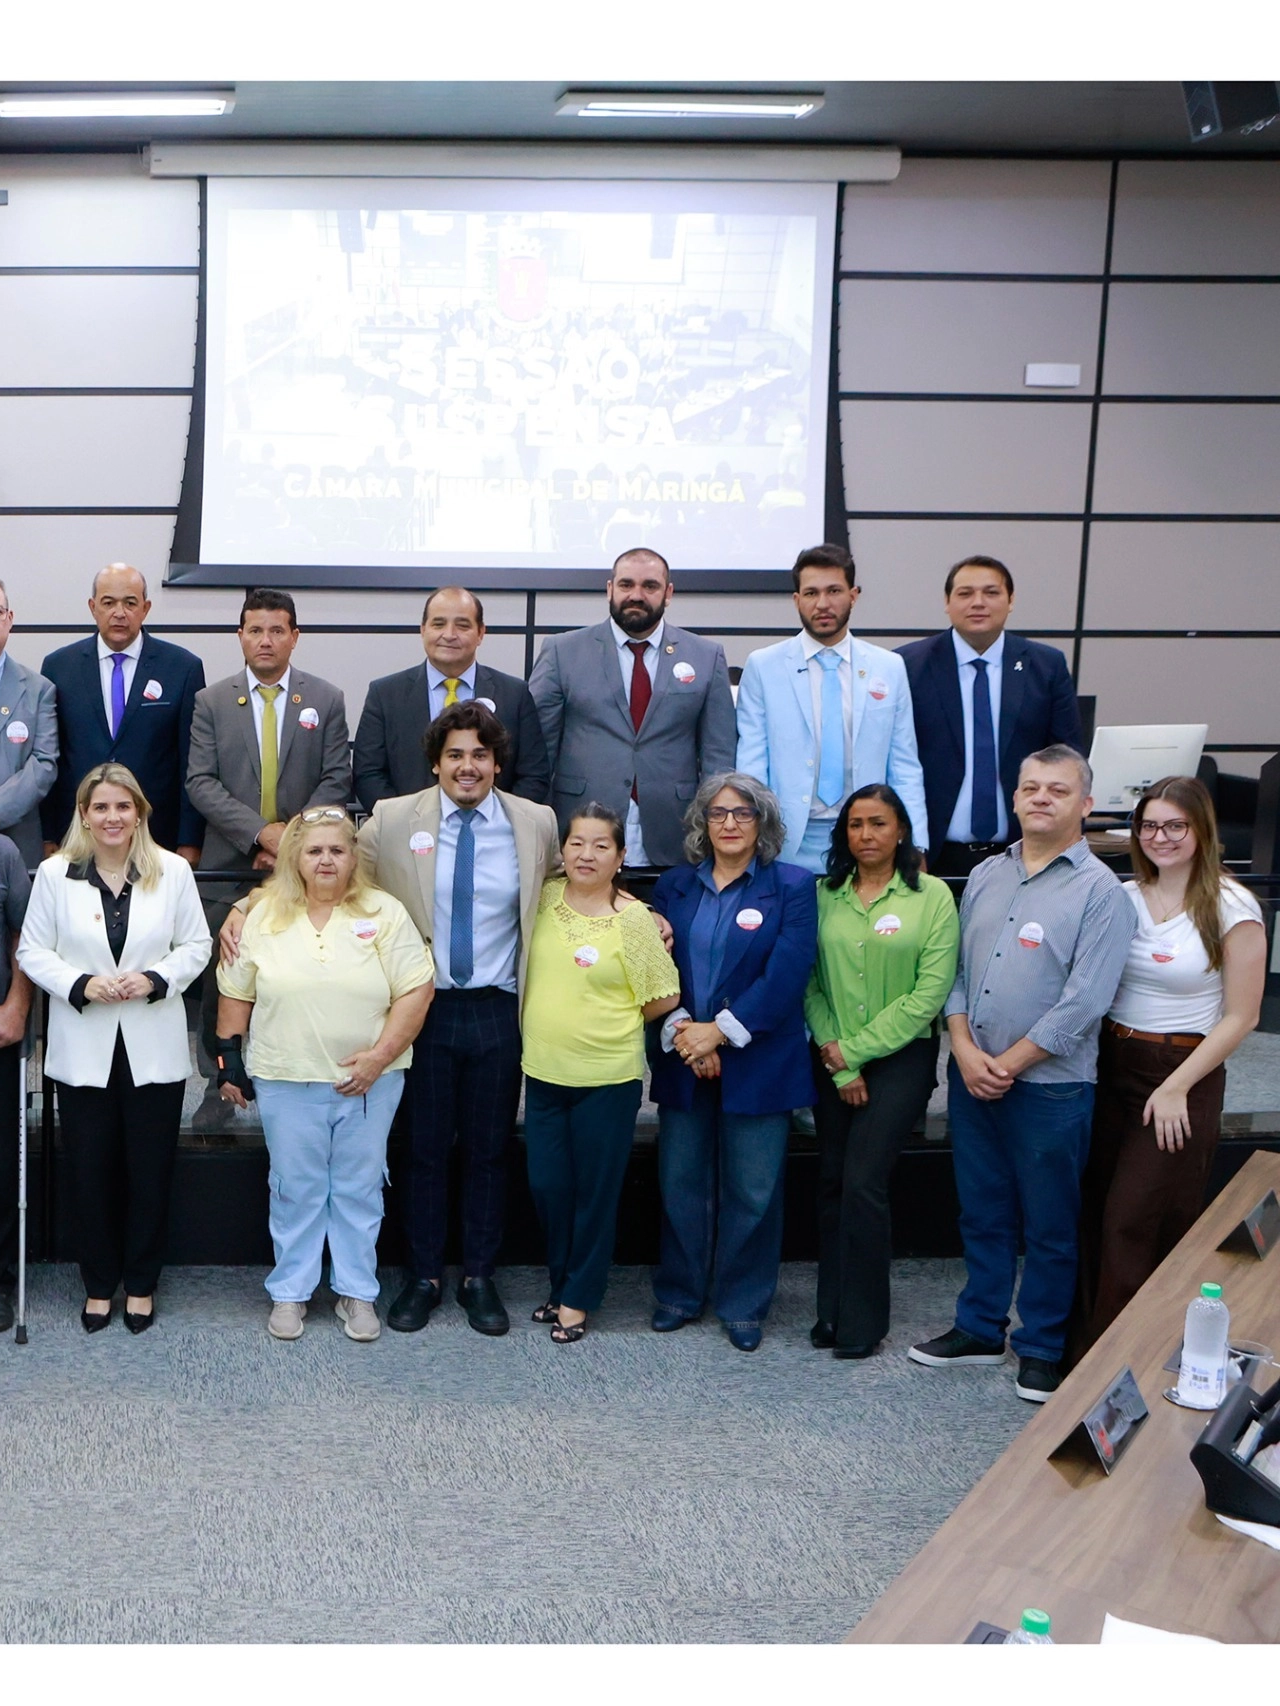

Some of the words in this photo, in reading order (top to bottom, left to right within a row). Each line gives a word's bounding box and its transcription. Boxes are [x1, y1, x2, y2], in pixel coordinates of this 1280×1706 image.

[283, 473, 402, 498] CÂMARA
[572, 480, 609, 500] DE
[618, 476, 746, 503] MARINGÁ
